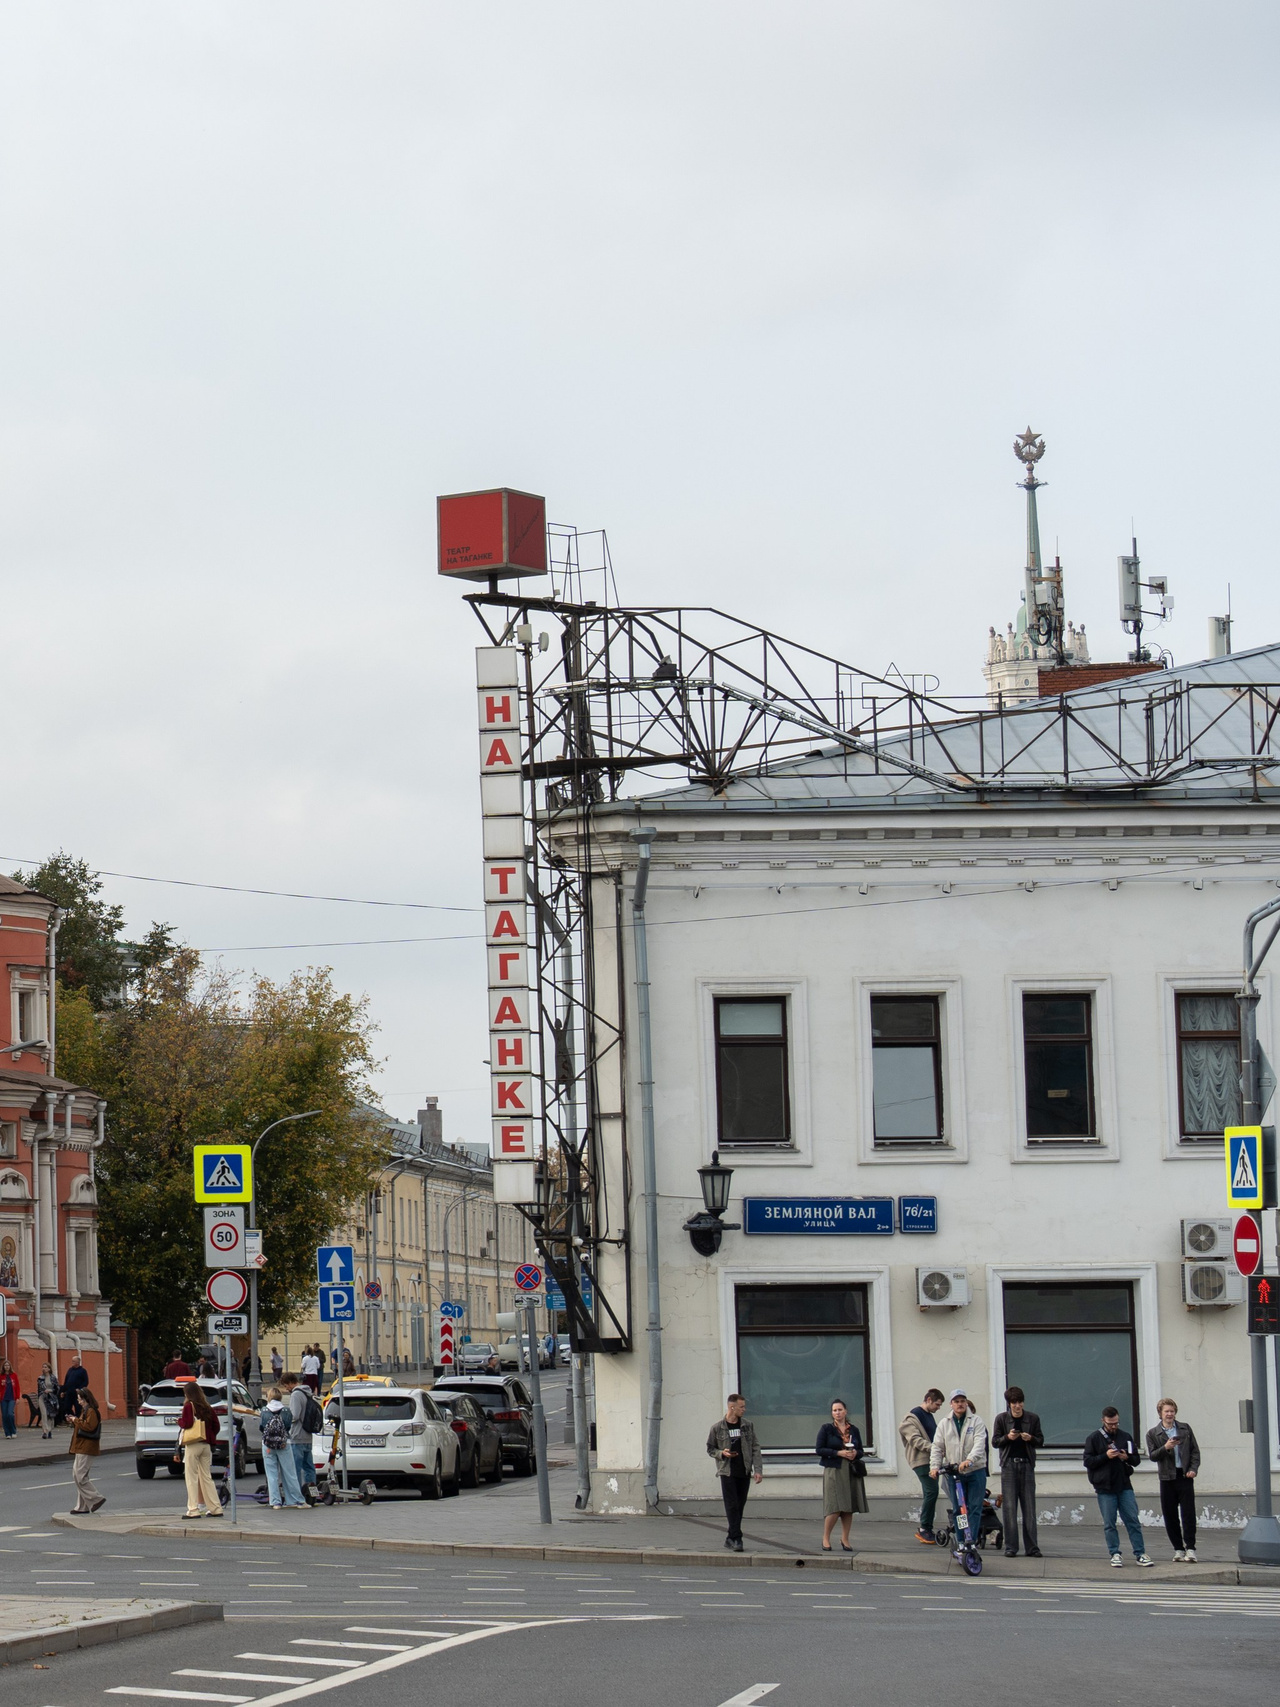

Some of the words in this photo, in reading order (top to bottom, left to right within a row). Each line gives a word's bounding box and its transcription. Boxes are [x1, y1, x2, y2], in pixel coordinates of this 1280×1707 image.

[446, 546, 471, 556] ТЕАТР
[459, 552, 493, 563] ТАГАНКЕ
[485, 695, 513, 766] НА
[490, 866, 526, 1153] ТАГАНКЕ
[212, 1210, 236, 1218] ЗОНА
[764, 1205, 843, 1219] ЗЕМЛЯНОЙ
[848, 1207, 876, 1219] ВАЛ
[904, 1204, 932, 1218] 76/21
[804, 1220, 836, 1228] УЛИЦА
[216, 1231, 232, 1243] 50
[328, 1290, 348, 1318] P
